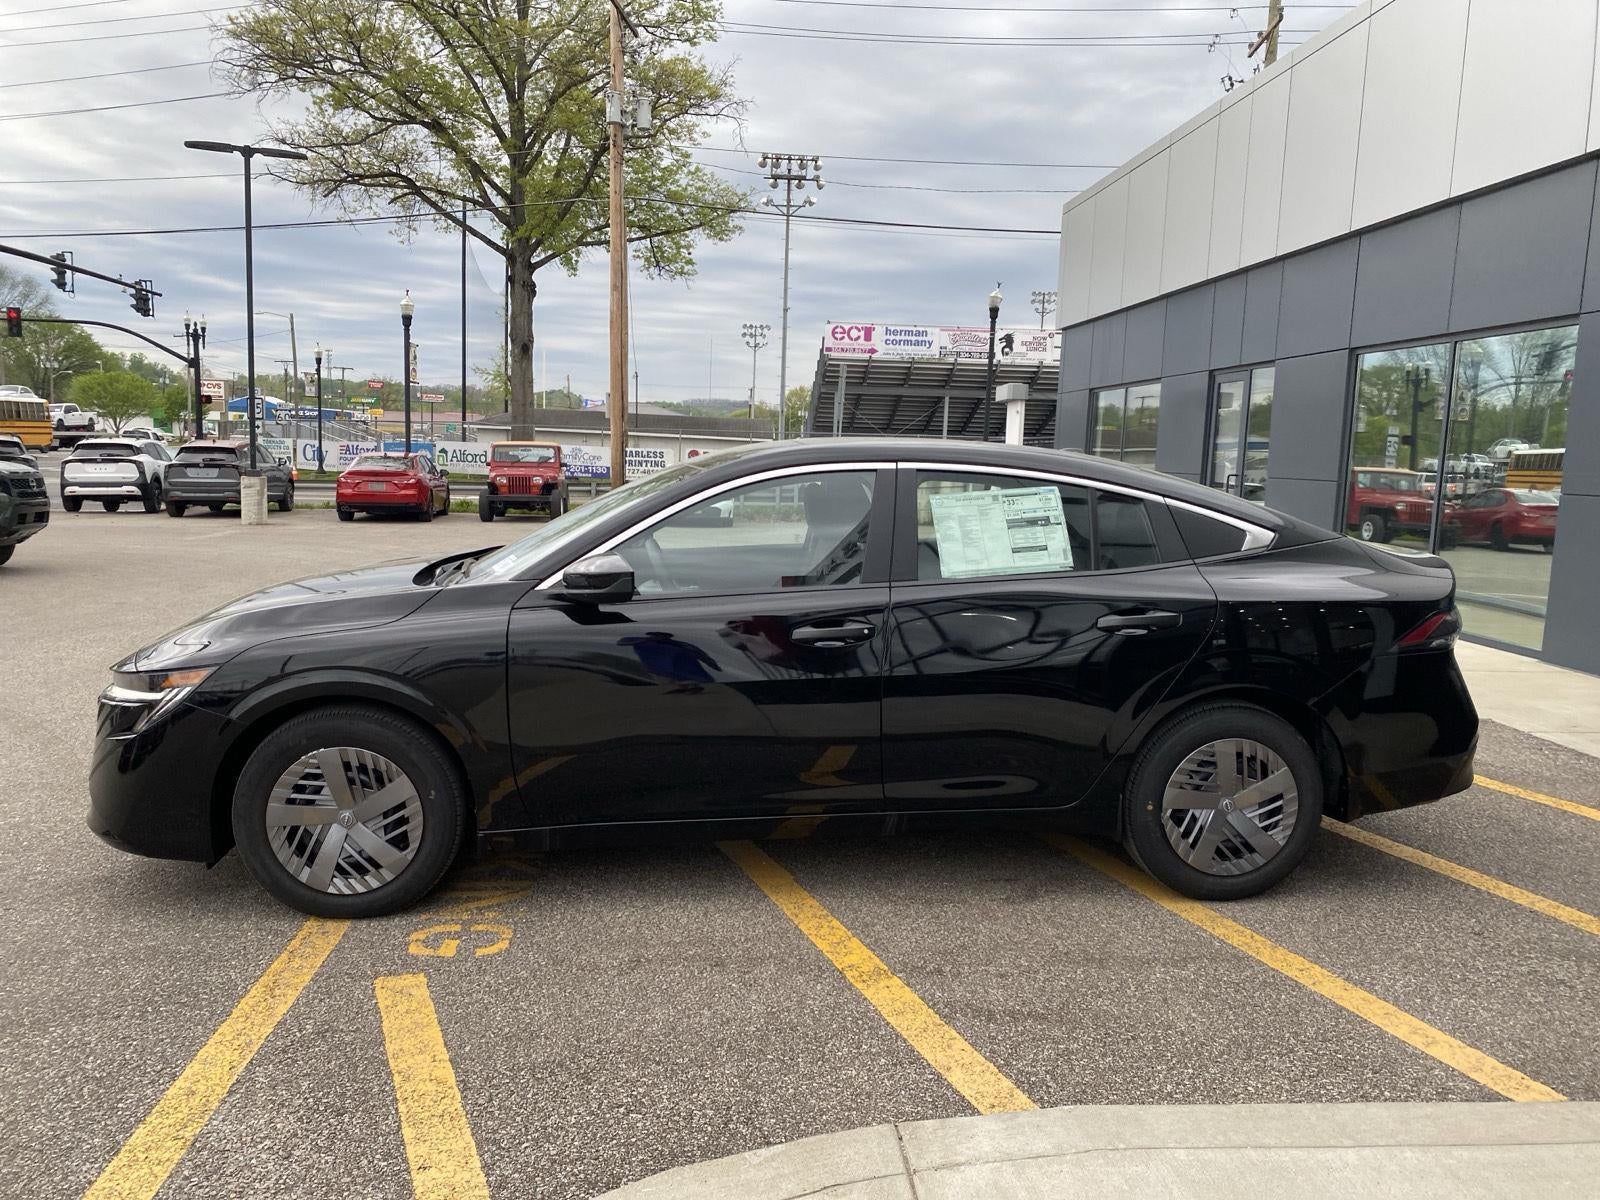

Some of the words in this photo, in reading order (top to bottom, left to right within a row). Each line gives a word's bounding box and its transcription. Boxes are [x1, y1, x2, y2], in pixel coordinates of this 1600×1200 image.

[885, 327, 928, 337] herman
[884, 338, 934, 349] cormany
[277, 413, 290, 421] 60
[450, 449, 487, 463] Alford
